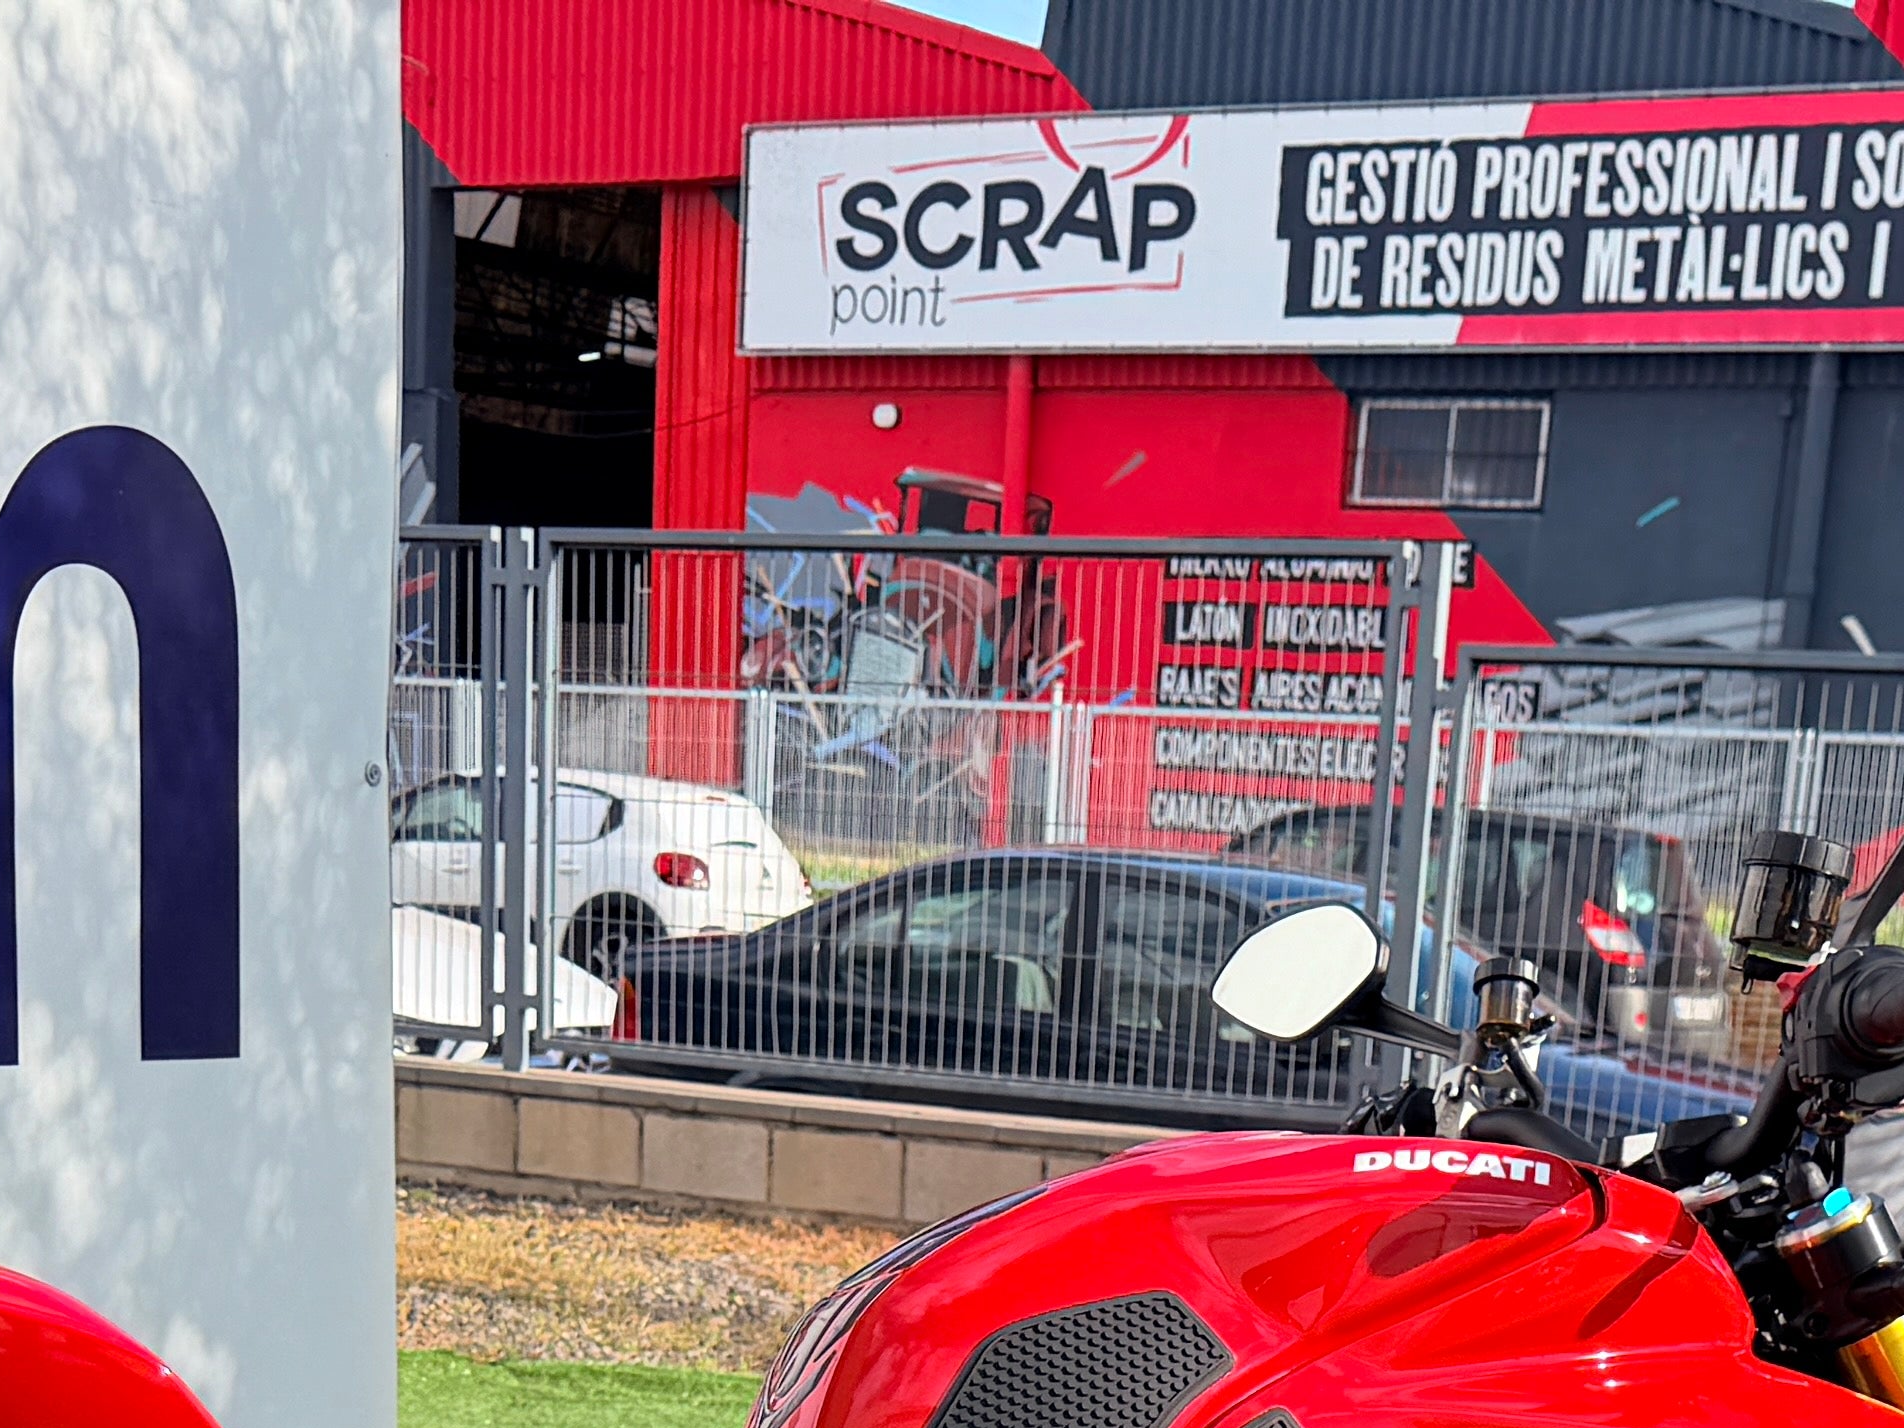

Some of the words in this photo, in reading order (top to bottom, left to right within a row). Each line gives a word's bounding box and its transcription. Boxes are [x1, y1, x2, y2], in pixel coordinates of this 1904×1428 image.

[1307, 138, 1456, 228] GESTIÓ
[1472, 131, 1807, 222] PROFESSIONAL
[1822, 131, 1843, 211] I
[835, 166, 1195, 271] SCRAP
[830, 274, 948, 335] point
[1312, 236, 1367, 310] DE
[1381, 228, 1564, 308] RESIDUS
[1265, 605, 1387, 647] INOXIDABL
[1353, 1150, 1551, 1186] DUCATI
